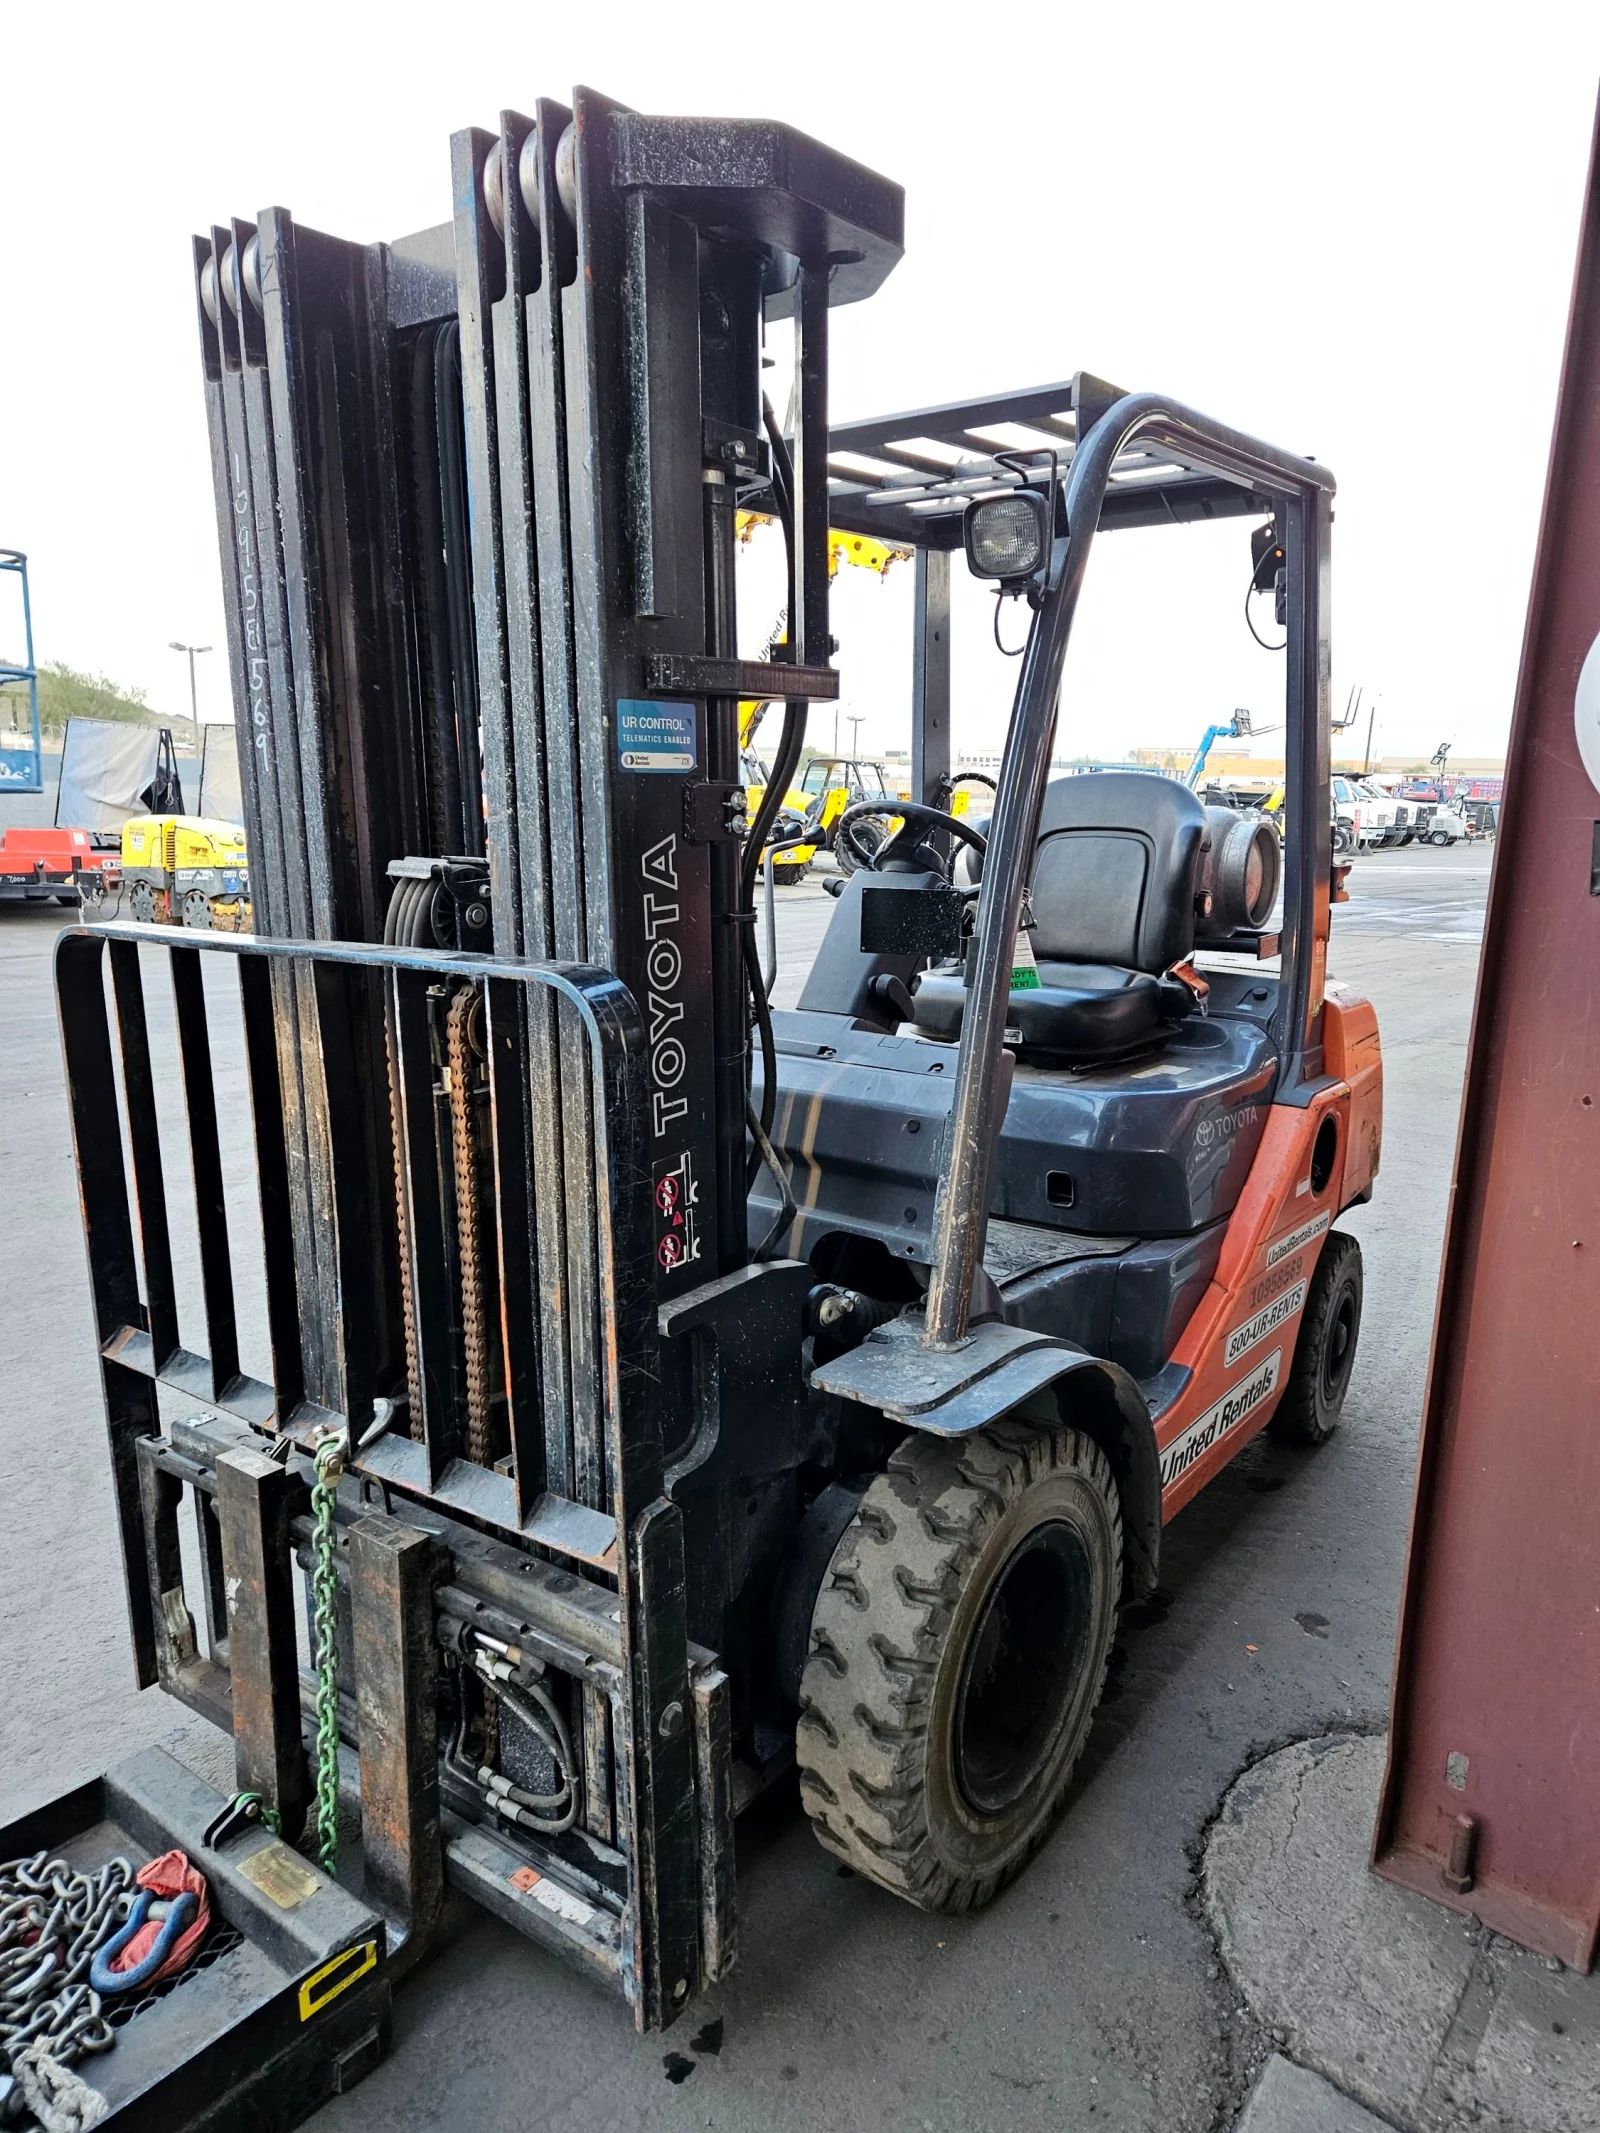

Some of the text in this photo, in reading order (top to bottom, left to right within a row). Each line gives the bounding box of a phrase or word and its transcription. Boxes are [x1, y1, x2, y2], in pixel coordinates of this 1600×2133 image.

[622, 716, 685, 731] UR CONTROL
[623, 734, 691, 745] TELEMATICS ENABLED
[642, 833, 687, 1138] TOYOTA
[1215, 1105, 1258, 1137] TOYOTA
[1228, 1286, 1304, 1358] 800-UR-RENTS
[1161, 1366, 1274, 1487] United Rentals
